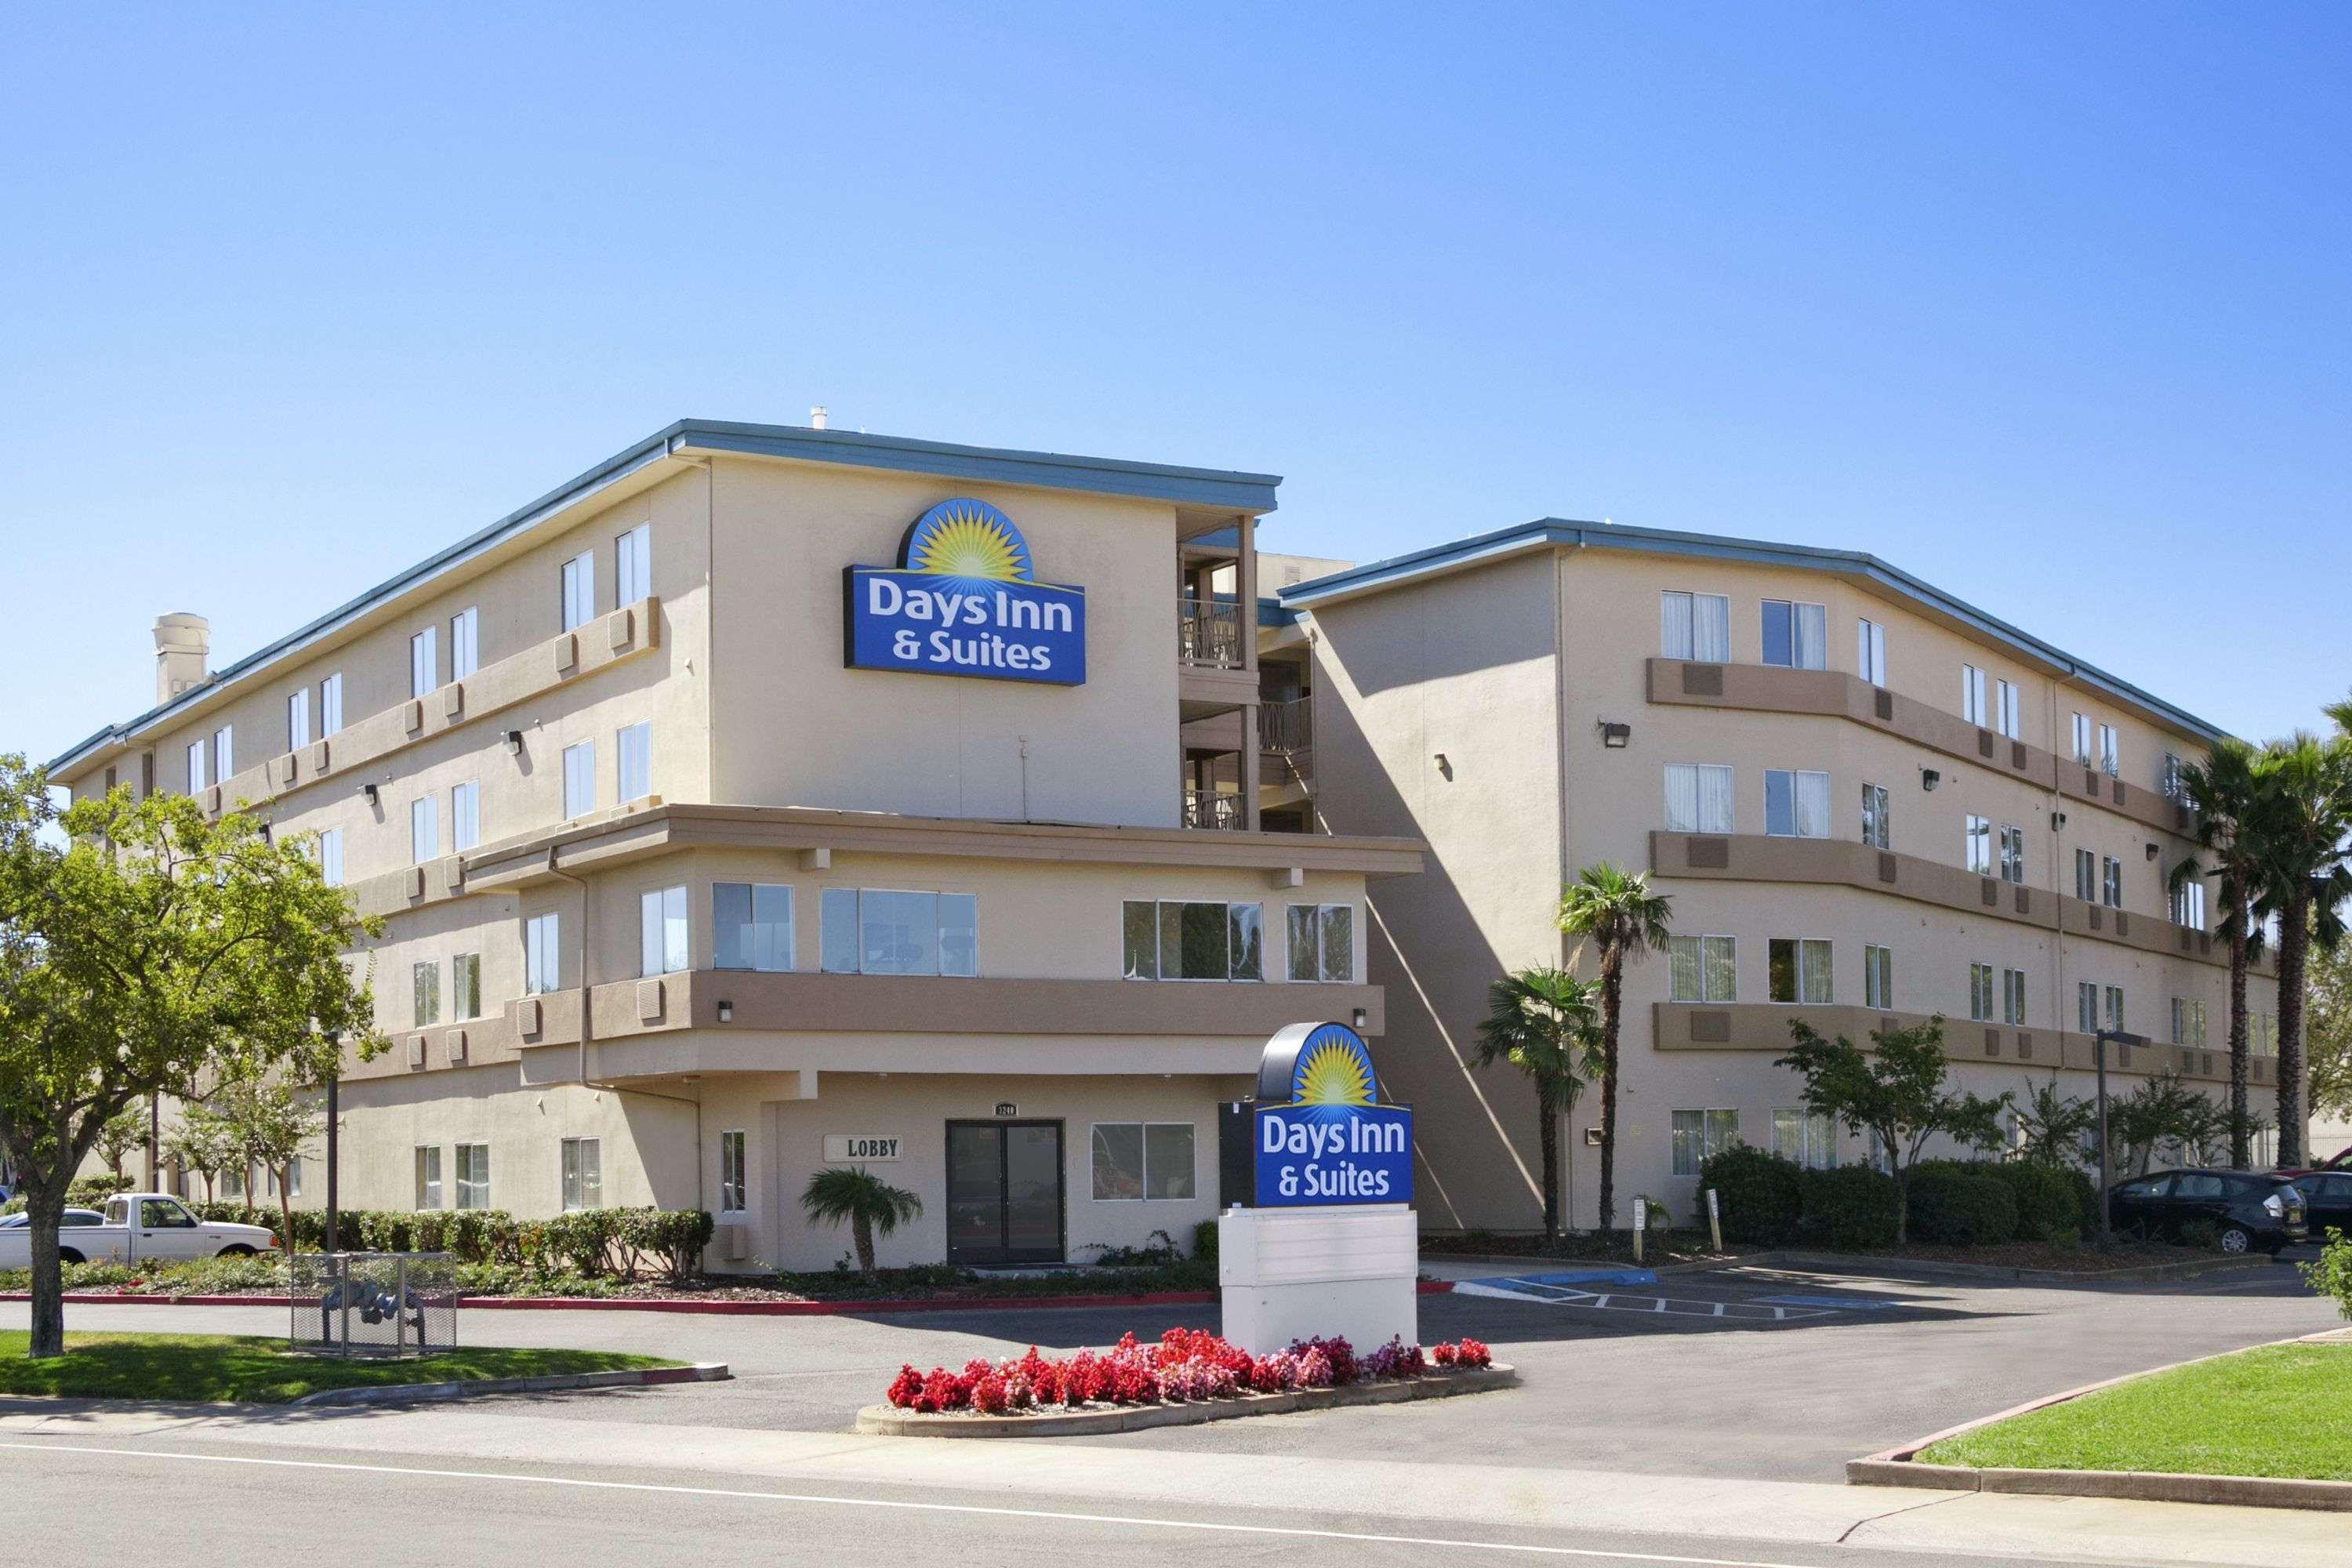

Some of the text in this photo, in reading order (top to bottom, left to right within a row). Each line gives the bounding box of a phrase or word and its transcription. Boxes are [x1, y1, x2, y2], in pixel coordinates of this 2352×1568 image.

[869, 577, 1072, 633] Days Inn
[892, 630, 1051, 671] & Suites
[848, 1139, 898, 1157] LOBBY
[1263, 1115, 1405, 1160] Days Inn
[1279, 1160, 1390, 1196] & Suites
